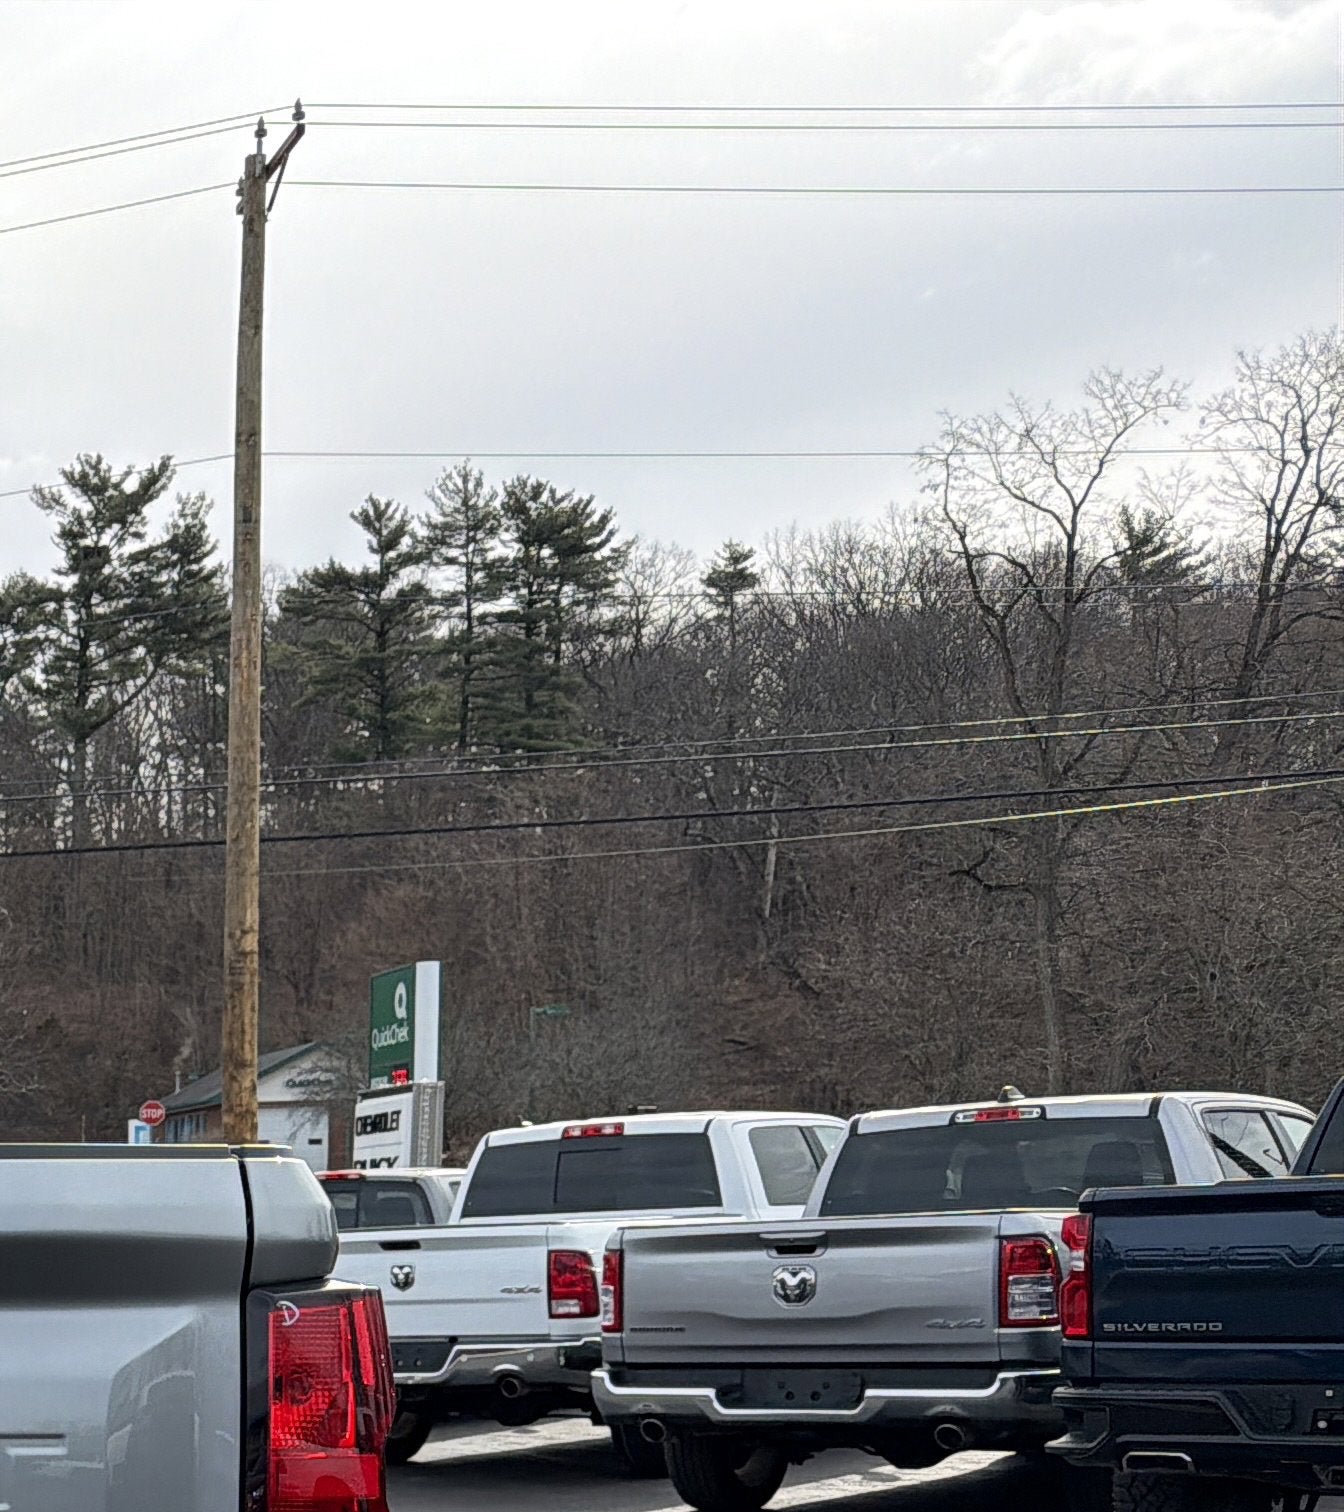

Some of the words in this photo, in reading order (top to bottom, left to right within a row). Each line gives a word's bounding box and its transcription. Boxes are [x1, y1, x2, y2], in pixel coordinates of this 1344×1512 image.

[372, 1022, 409, 1051] QuickChek
[142, 1108, 163, 1119] STOP
[356, 1110, 402, 1136] CHEVROLET
[1103, 1322, 1223, 1332] SILVERADO
